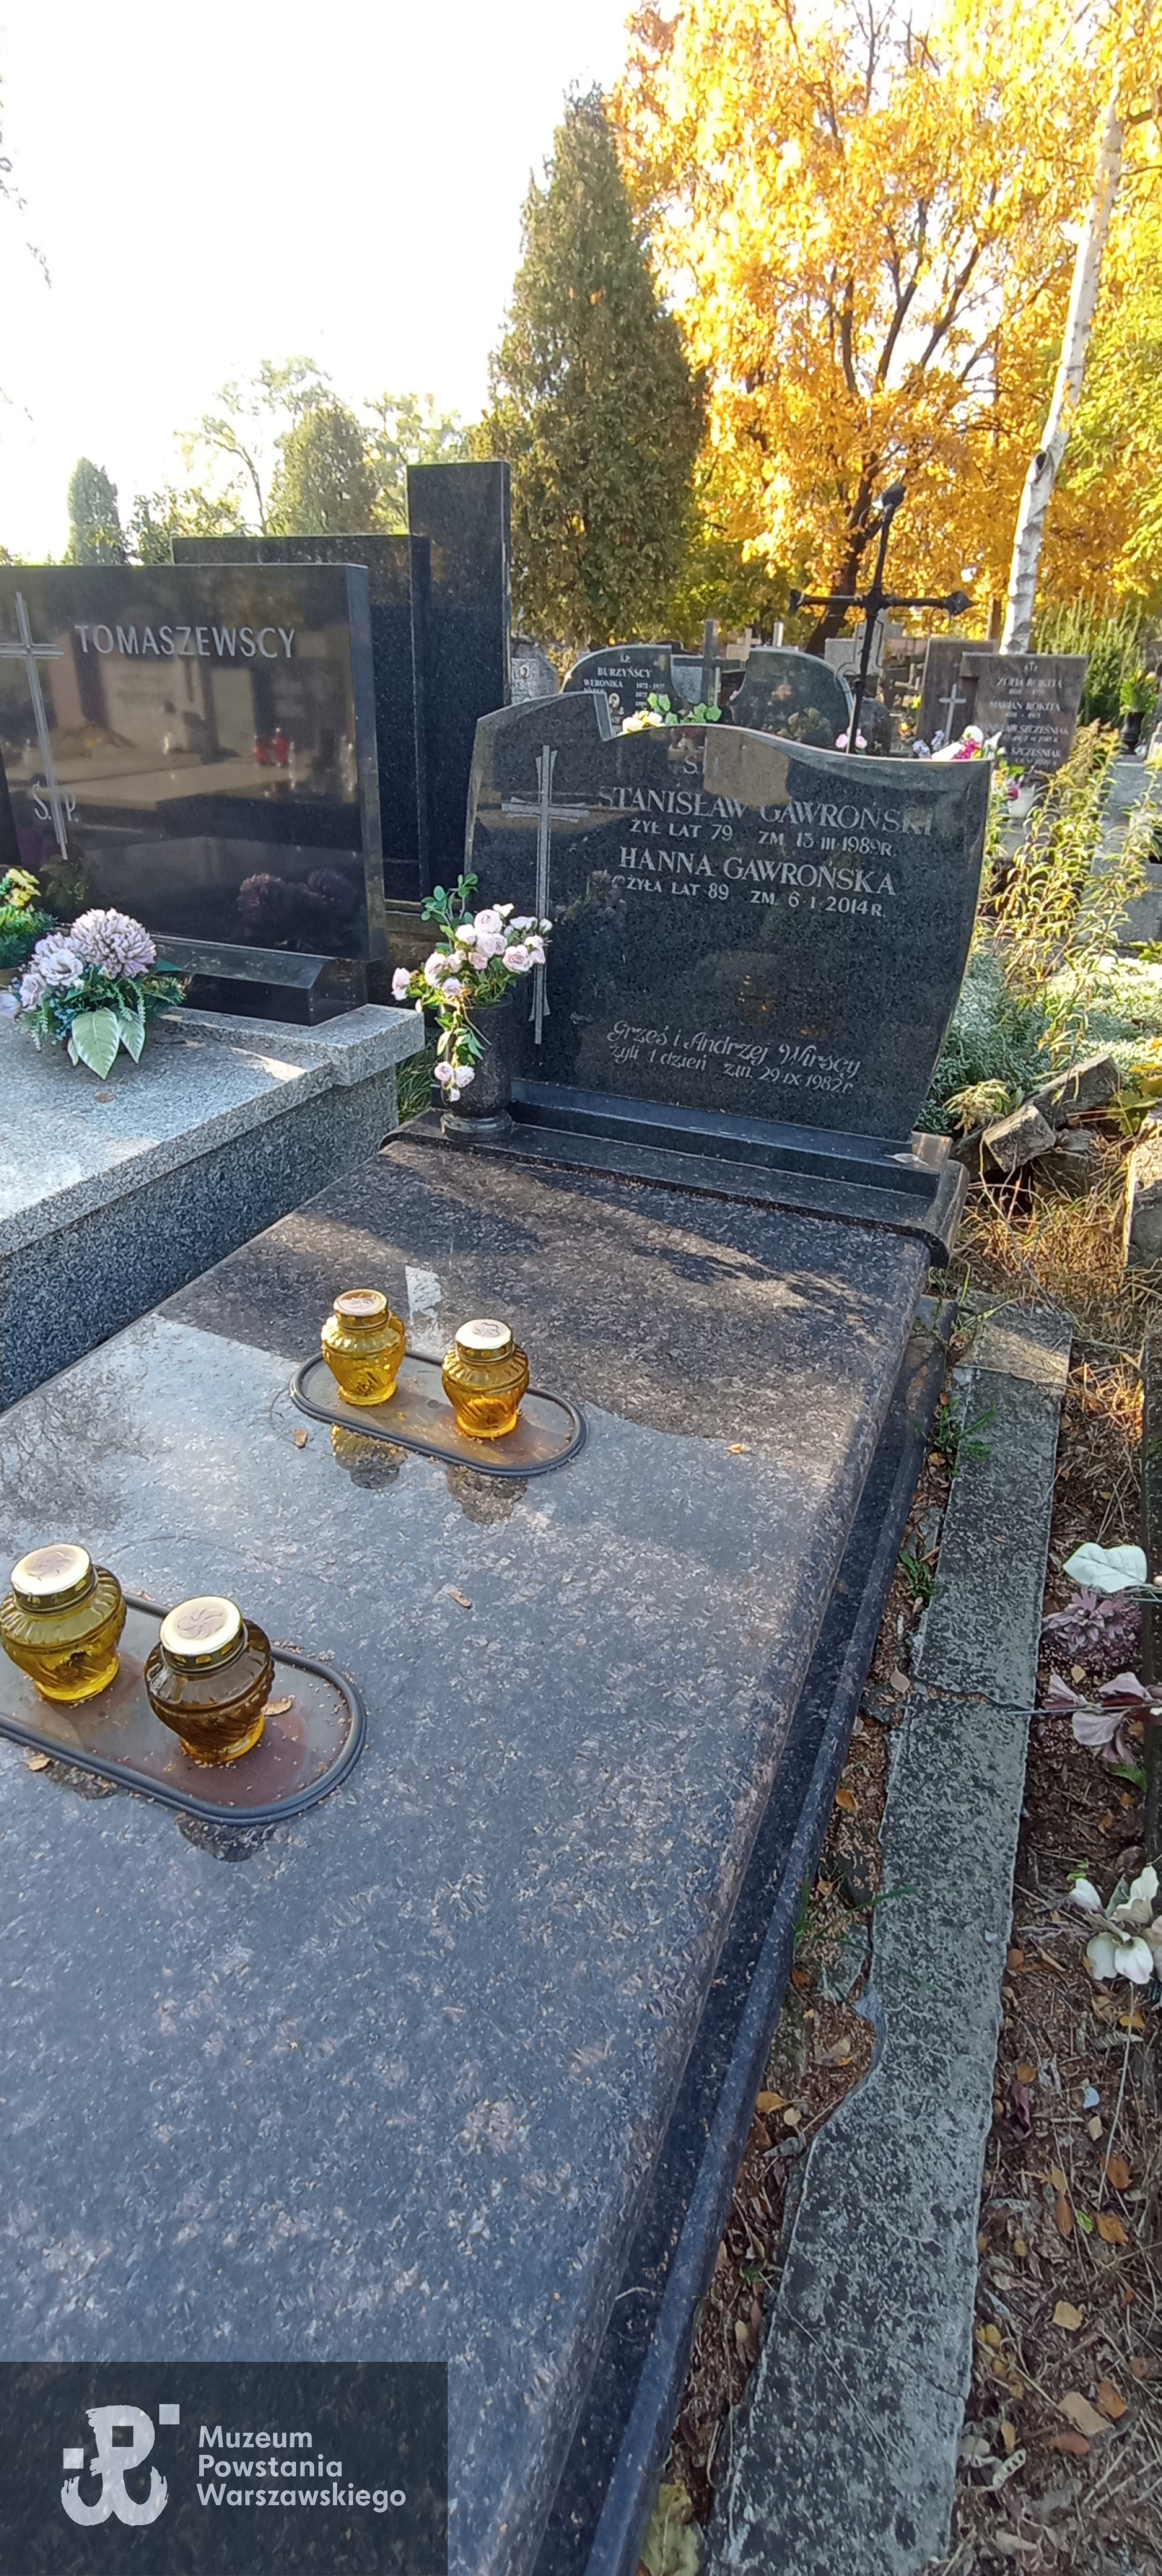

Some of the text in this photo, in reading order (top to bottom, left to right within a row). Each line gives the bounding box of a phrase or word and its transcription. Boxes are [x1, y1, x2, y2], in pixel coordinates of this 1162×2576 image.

[74, 624, 295, 658] TOMASZEWSCY
[583, 678, 623, 688] WERONIKA
[597, 666, 652, 678] BURZYŃSCY
[596, 785, 933, 836] STANISŁAW GAWROŃSKI
[629, 817, 661, 834] ŻYŁ
[669, 822, 702, 838] LAT
[711, 824, 734, 842] 79
[618, 845, 897, 896] HANNA GAWROŃSKA
[626, 874, 663, 893] ŻYŁA
[671, 882, 701, 896] LAT
[707, 882, 729, 900] 89
[606, 1020, 861, 1080] Grześ i Andrzej Wirscy
[609, 1043, 640, 1064] żyli
[648, 1048, 657, 1063] 1
[660, 1051, 707, 1071] dzień
